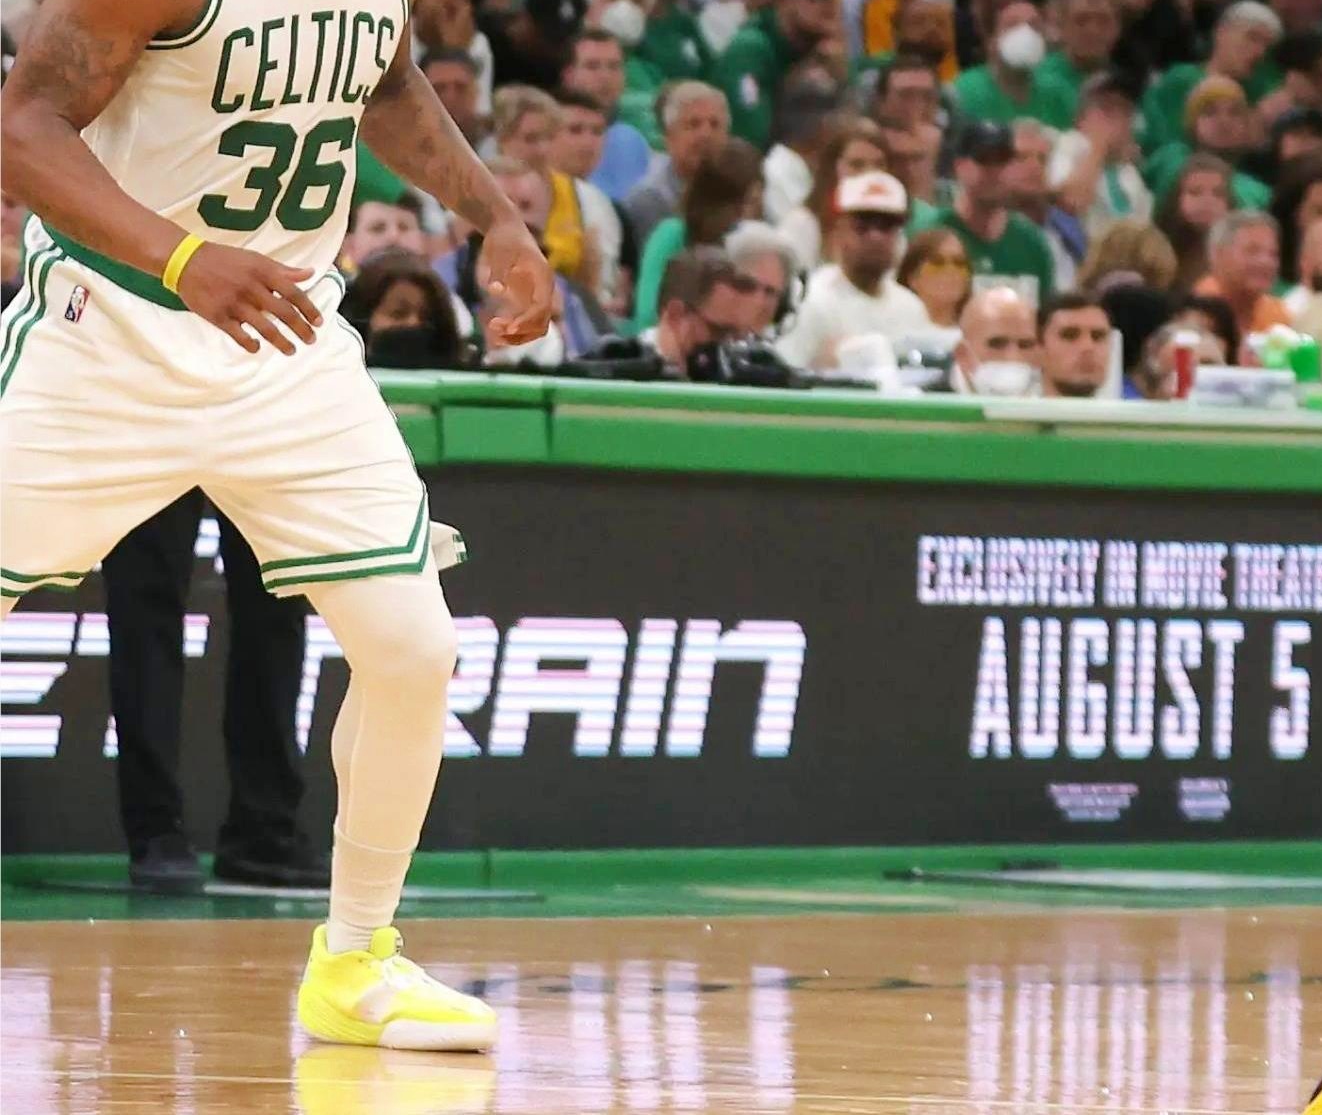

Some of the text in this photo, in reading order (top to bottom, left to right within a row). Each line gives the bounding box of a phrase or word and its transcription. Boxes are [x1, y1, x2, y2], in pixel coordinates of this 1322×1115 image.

[211, 10, 395, 114] CELTICS
[197, 116, 357, 232] 36
[917, 536, 1100, 606] EXCLUSIVELY
[1103, 540, 1137, 608] IN
[1140, 541, 1229, 610] MOVIE
[968, 616, 1312, 761] AUGUST 5
